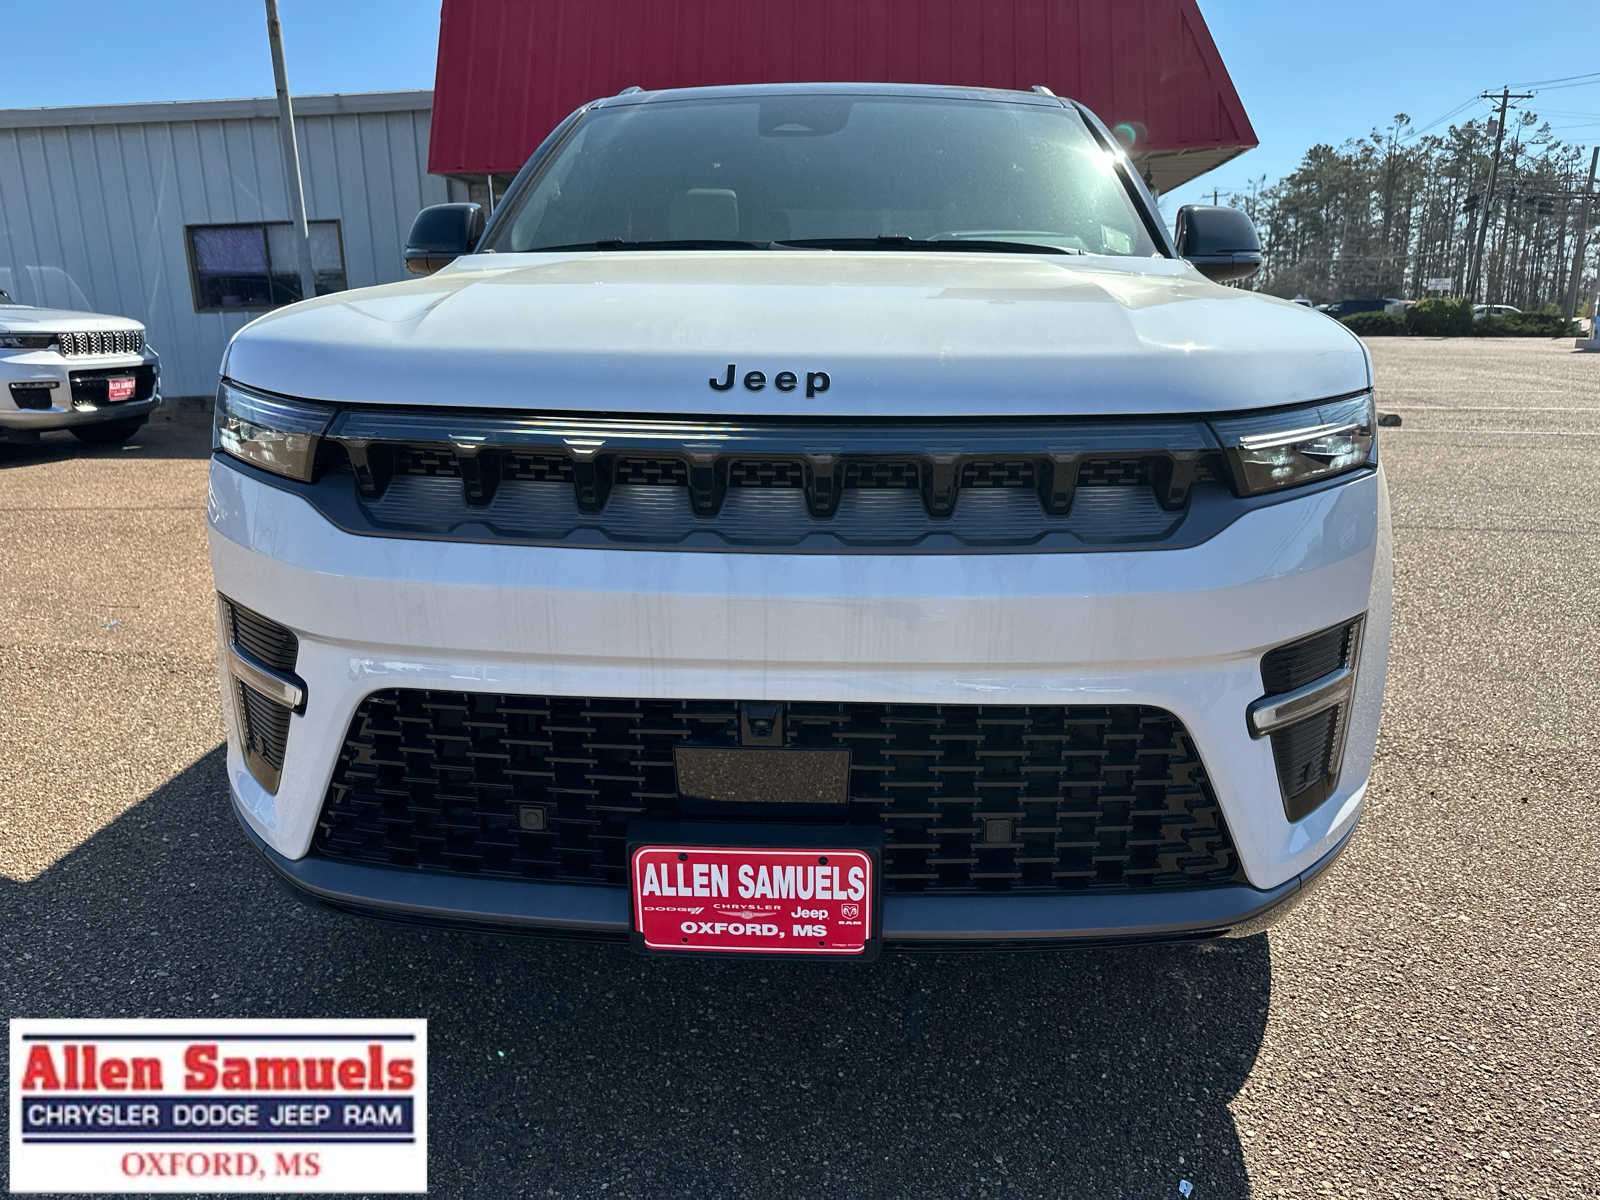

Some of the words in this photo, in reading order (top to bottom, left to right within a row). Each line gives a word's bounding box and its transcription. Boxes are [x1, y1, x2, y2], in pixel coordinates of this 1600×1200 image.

[709, 364, 831, 398] Jeep
[642, 863, 729, 898] ALLEN
[738, 864, 865, 901] SAMUELS
[713, 903, 781, 911] CHRYSLER
[791, 906, 829, 920] Jeep
[680, 921, 785, 939] OXFORD,
[793, 924, 827, 937] MS
